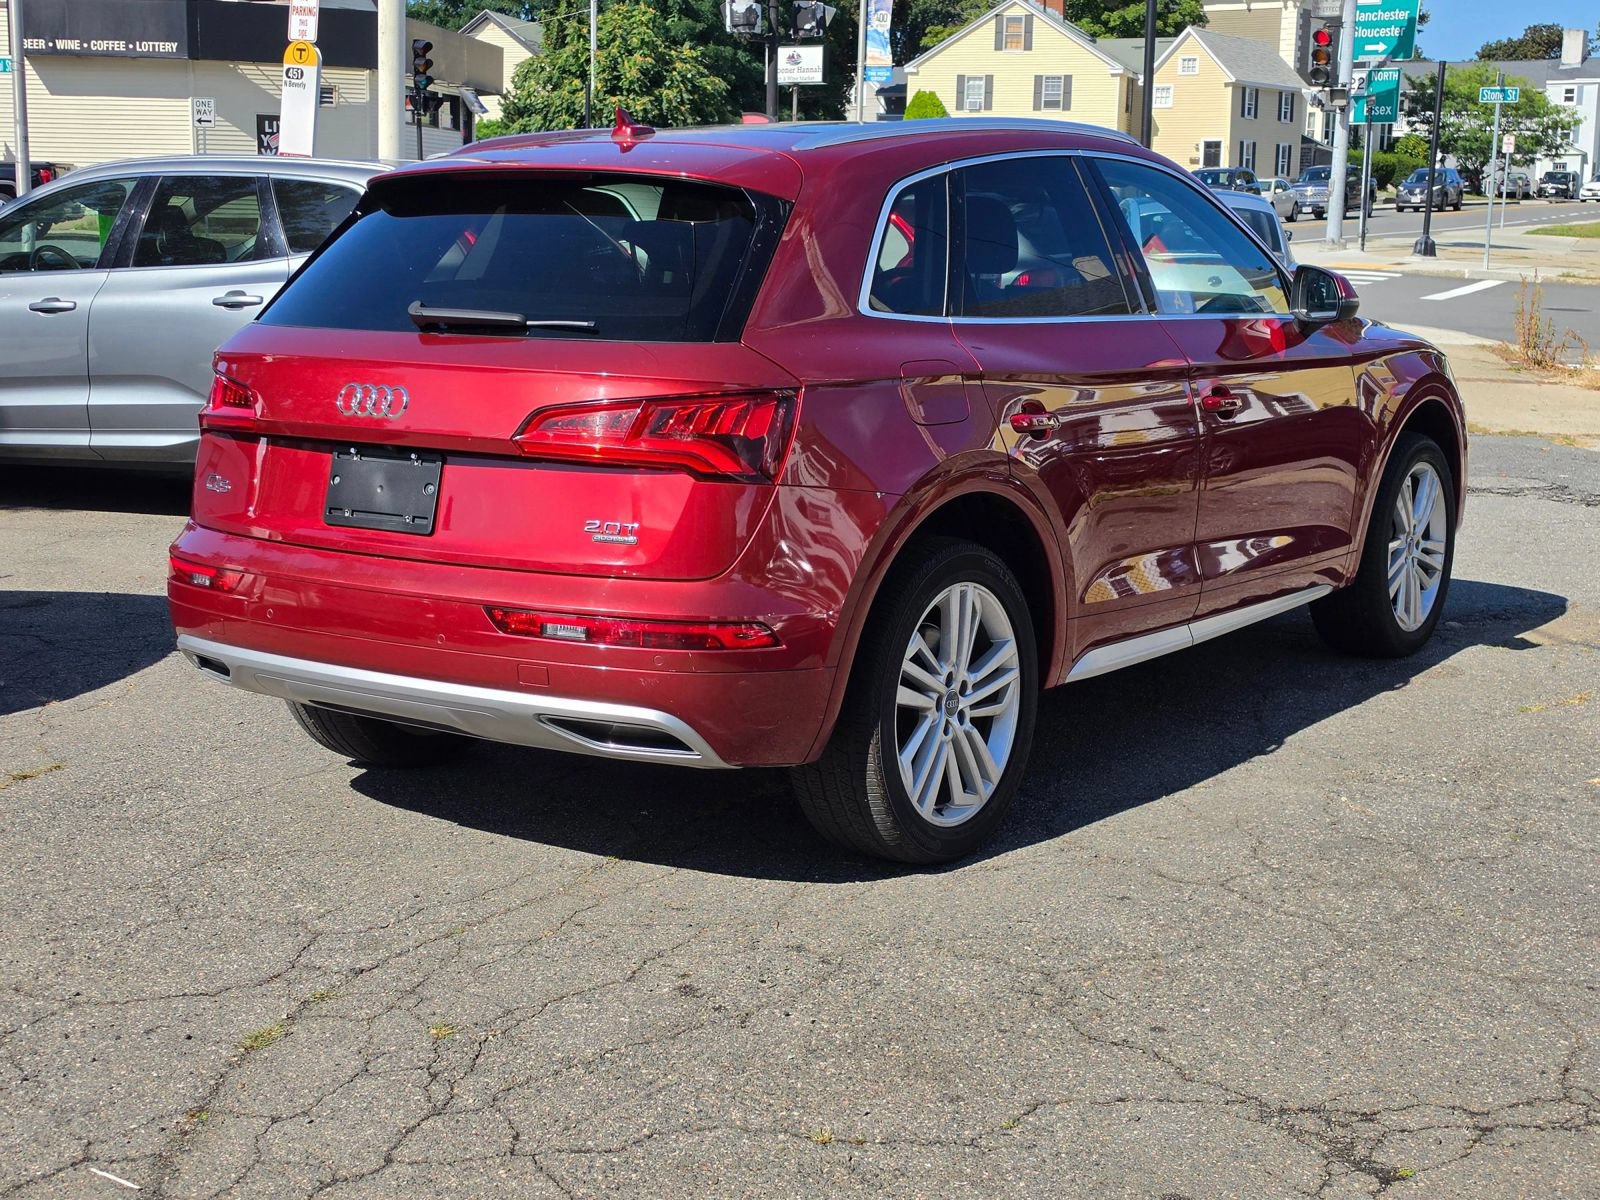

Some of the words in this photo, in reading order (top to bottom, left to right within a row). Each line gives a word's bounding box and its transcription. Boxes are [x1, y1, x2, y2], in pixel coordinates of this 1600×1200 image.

[292, 5, 316, 16] PARKING
[1356, 8, 1410, 21] anchester
[55, 39, 81, 50] WINE
[90, 40, 126, 51] COFFEE
[136, 41, 178, 53] LOTTERY
[288, 68, 302, 79] 451
[1371, 71, 1399, 81] NORTH
[289, 81, 306, 90] Beverly
[1483, 89, 1505, 100] Stone
[1507, 89, 1516, 100] St
[195, 100, 213, 108] ONE
[195, 108, 213, 116] WAY
[584, 520, 640, 536] 2.0T
